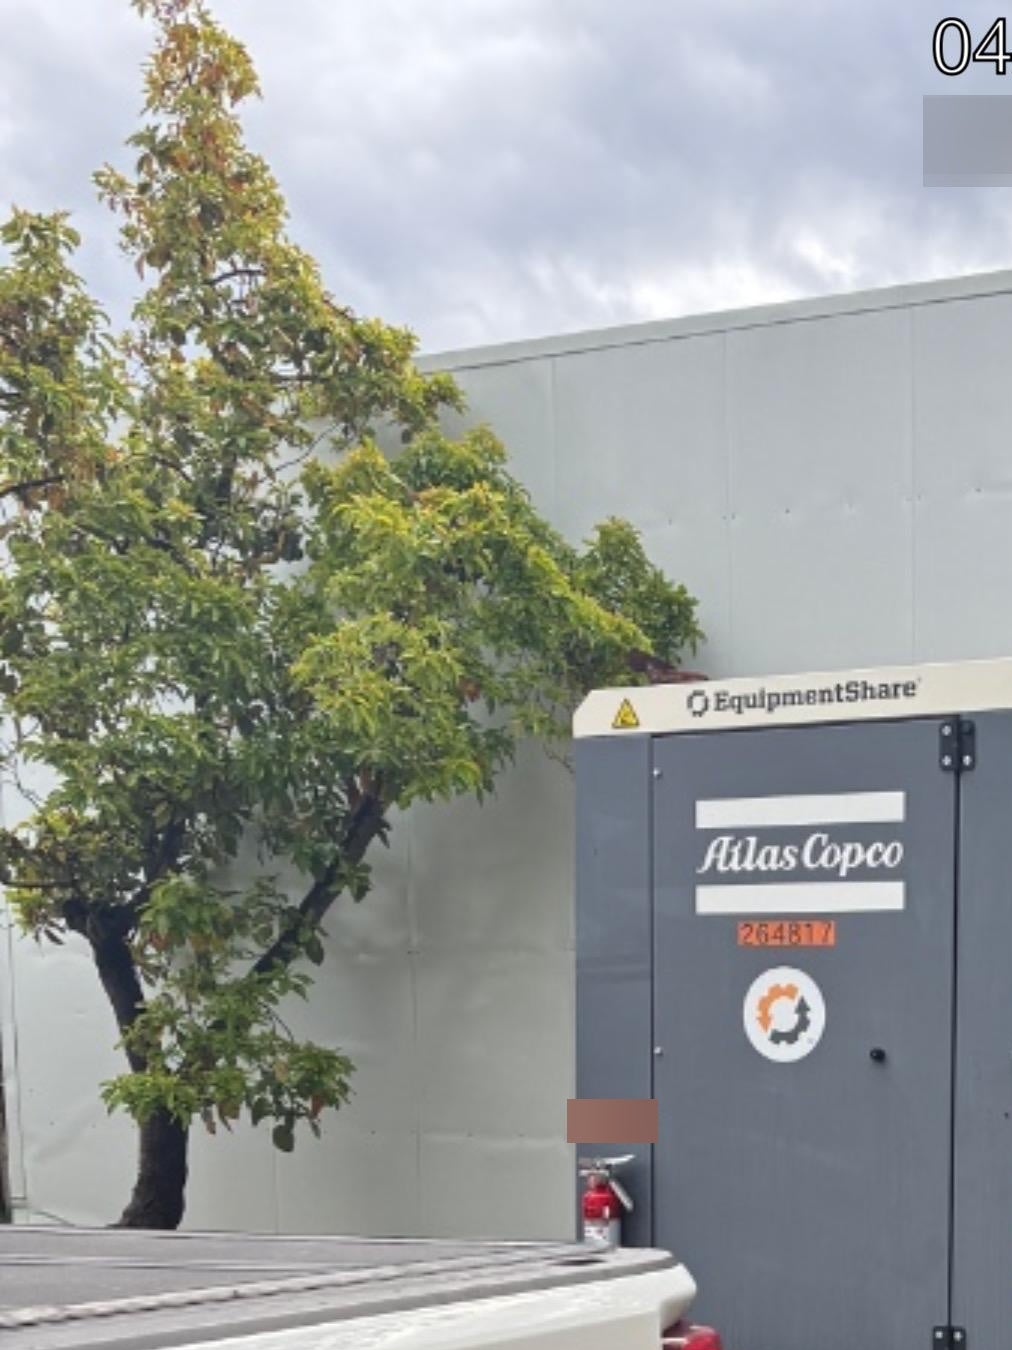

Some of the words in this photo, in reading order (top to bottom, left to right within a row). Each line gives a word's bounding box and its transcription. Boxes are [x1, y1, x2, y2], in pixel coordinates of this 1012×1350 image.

[713, 679, 917, 715] EquipmentShare
[696, 835, 799, 875] Atlas
[802, 832, 904, 877] Copco
[741, 922, 833, 945] 264817
